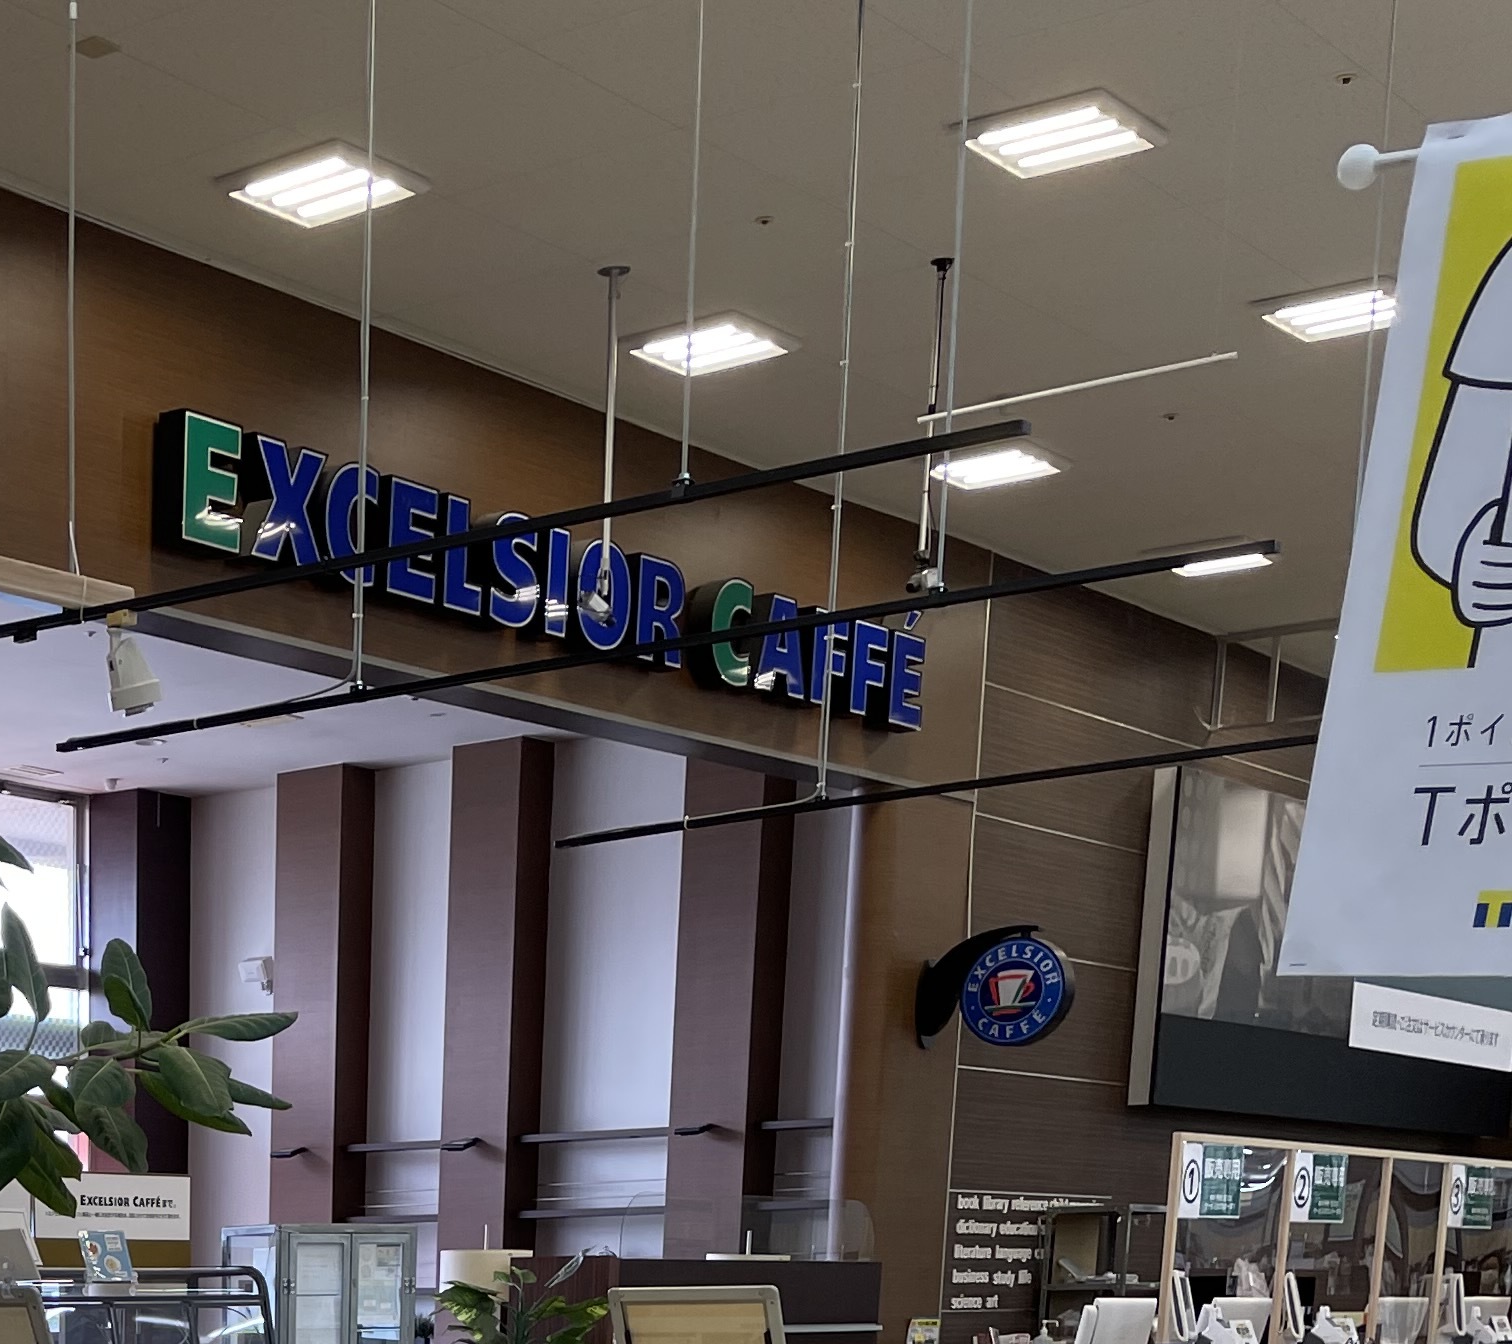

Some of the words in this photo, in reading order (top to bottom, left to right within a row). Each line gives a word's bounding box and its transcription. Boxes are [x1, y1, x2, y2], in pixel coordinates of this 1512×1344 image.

[182, 410, 686, 669] EXCELSIOR
[712, 577, 927, 731] CAFFÉ
[967, 944, 1060, 992] EXCELSIOR
[80, 1194, 130, 1207] EXCELSIOR
[956, 1194, 980, 1210] book
[981, 1195, 1010, 1214] library
[1011, 1196, 1049, 1212] reference
[955, 1219, 998, 1238] dictionary
[953, 1243, 992, 1260] literature
[995, 1244, 1033, 1263] language
[951, 1268, 990, 1284] business
[992, 1270, 1016, 1288] study
[1018, 1269, 1032, 1285] life
[950, 1294, 983, 1310] science
[985, 1294, 999, 1309] art
